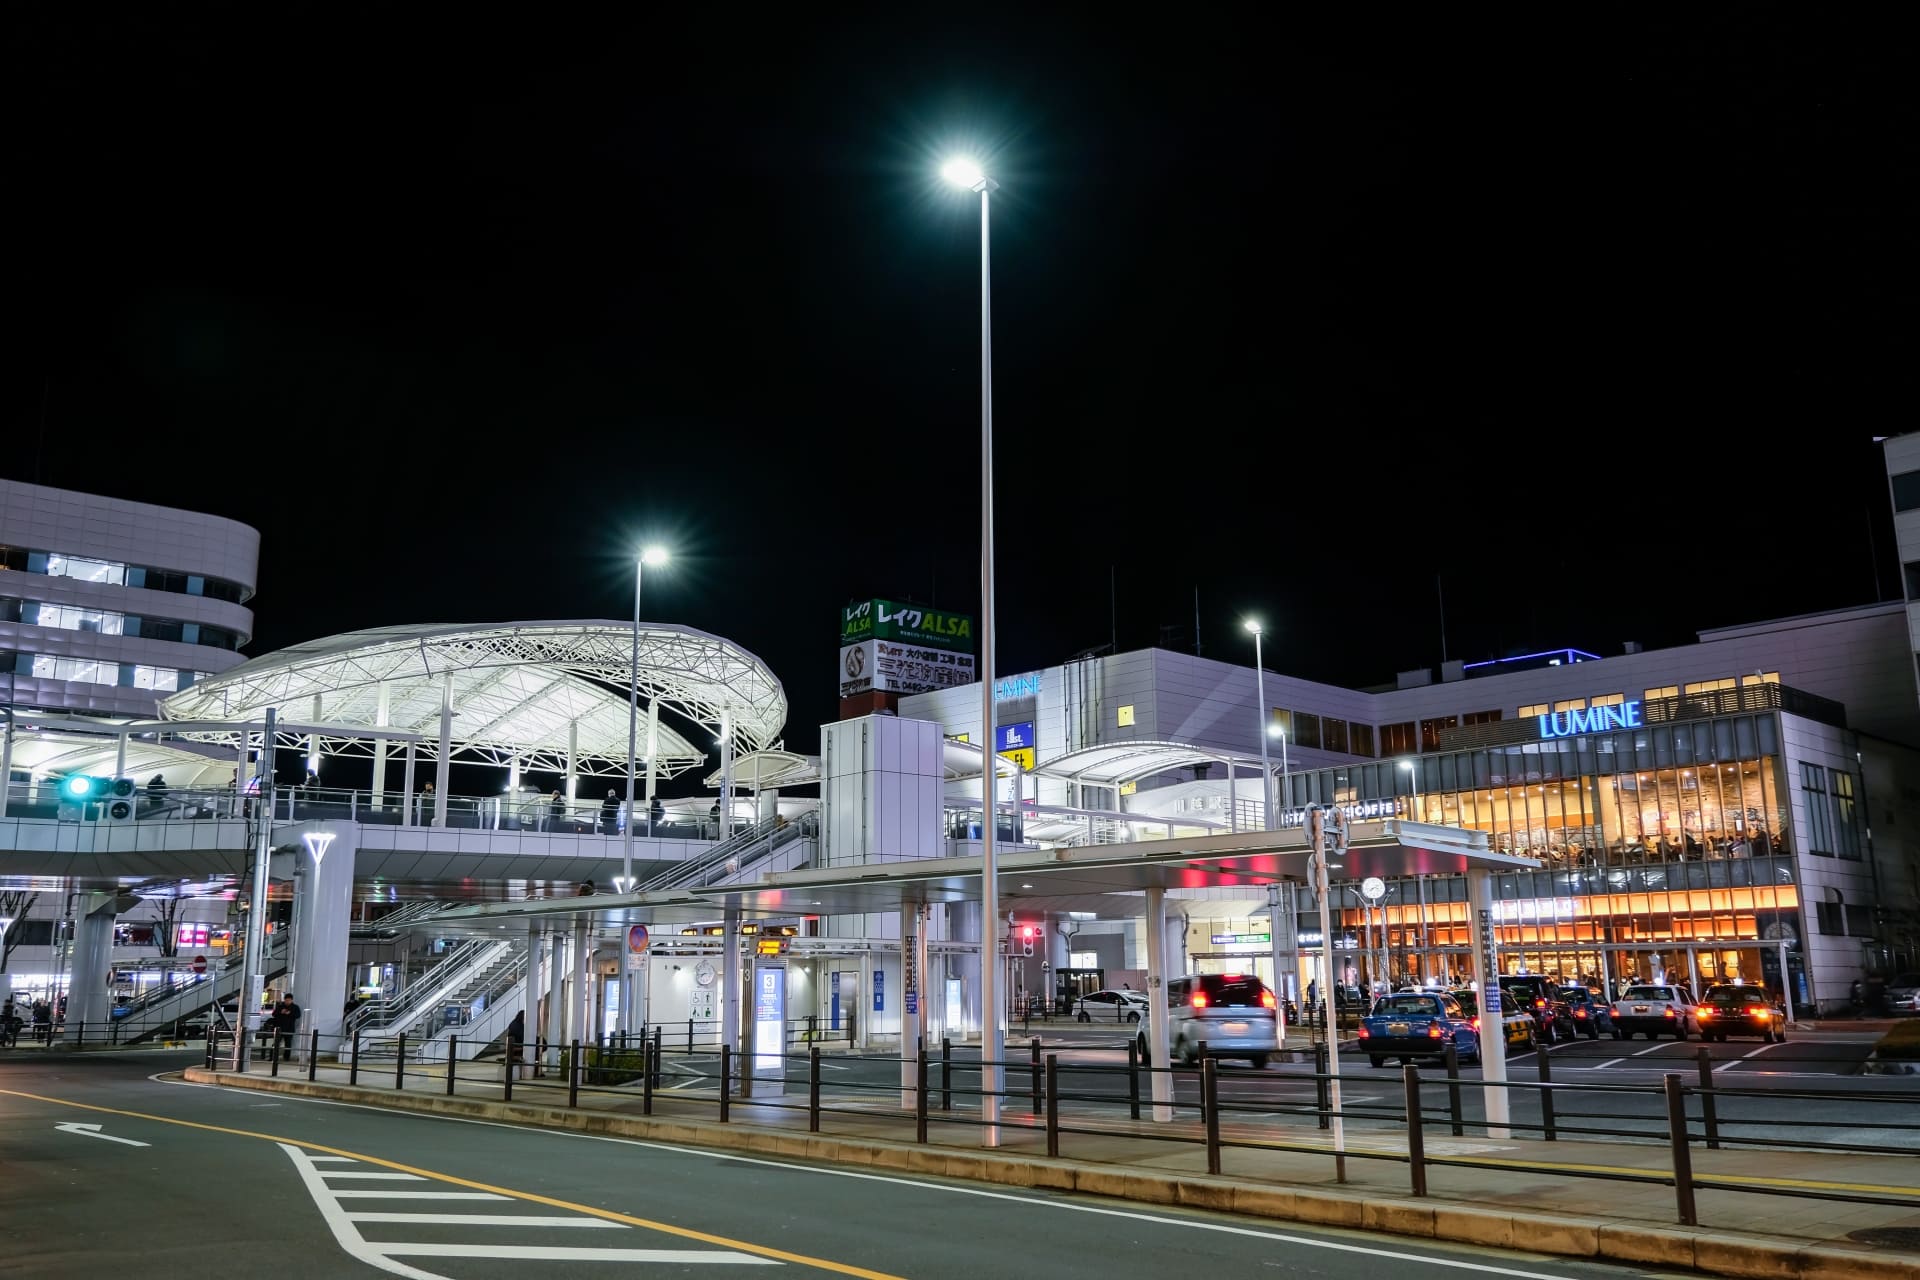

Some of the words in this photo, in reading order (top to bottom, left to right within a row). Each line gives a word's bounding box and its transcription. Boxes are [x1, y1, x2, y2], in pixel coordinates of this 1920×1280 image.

[846, 602, 871, 621] レイク
[878, 604, 971, 638] レイクALSA
[846, 617, 871, 634] ALSA
[994, 676, 1042, 701] UMINE
[1540, 701, 1642, 738] LUMINE
[744, 969, 751, 981] 3
[765, 976, 773, 988] 3
